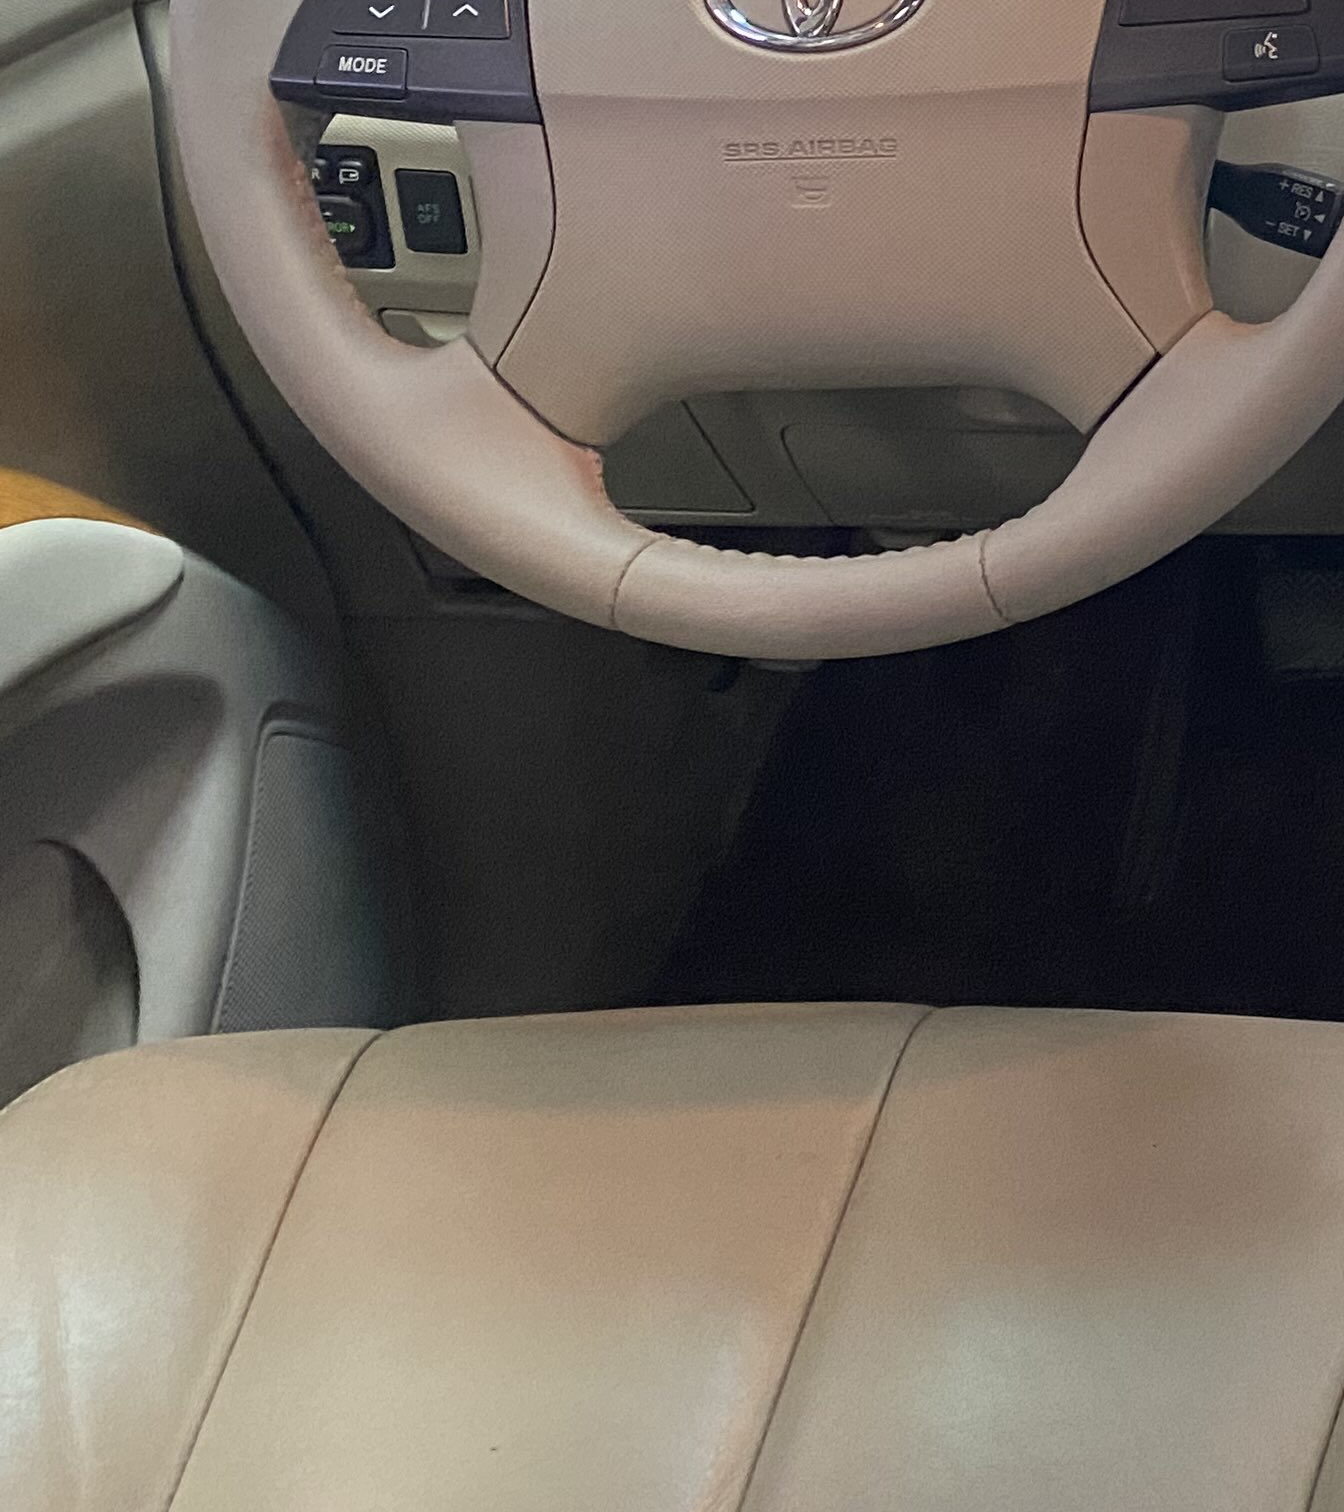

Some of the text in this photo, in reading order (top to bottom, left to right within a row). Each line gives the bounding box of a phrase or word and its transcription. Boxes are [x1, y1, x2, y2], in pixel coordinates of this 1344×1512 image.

[338, 56, 387, 74] MODE
[723, 138, 897, 157] SRS AIRBAG
[1291, 183, 1313, 199] RES
[1277, 221, 1300, 237] SET
